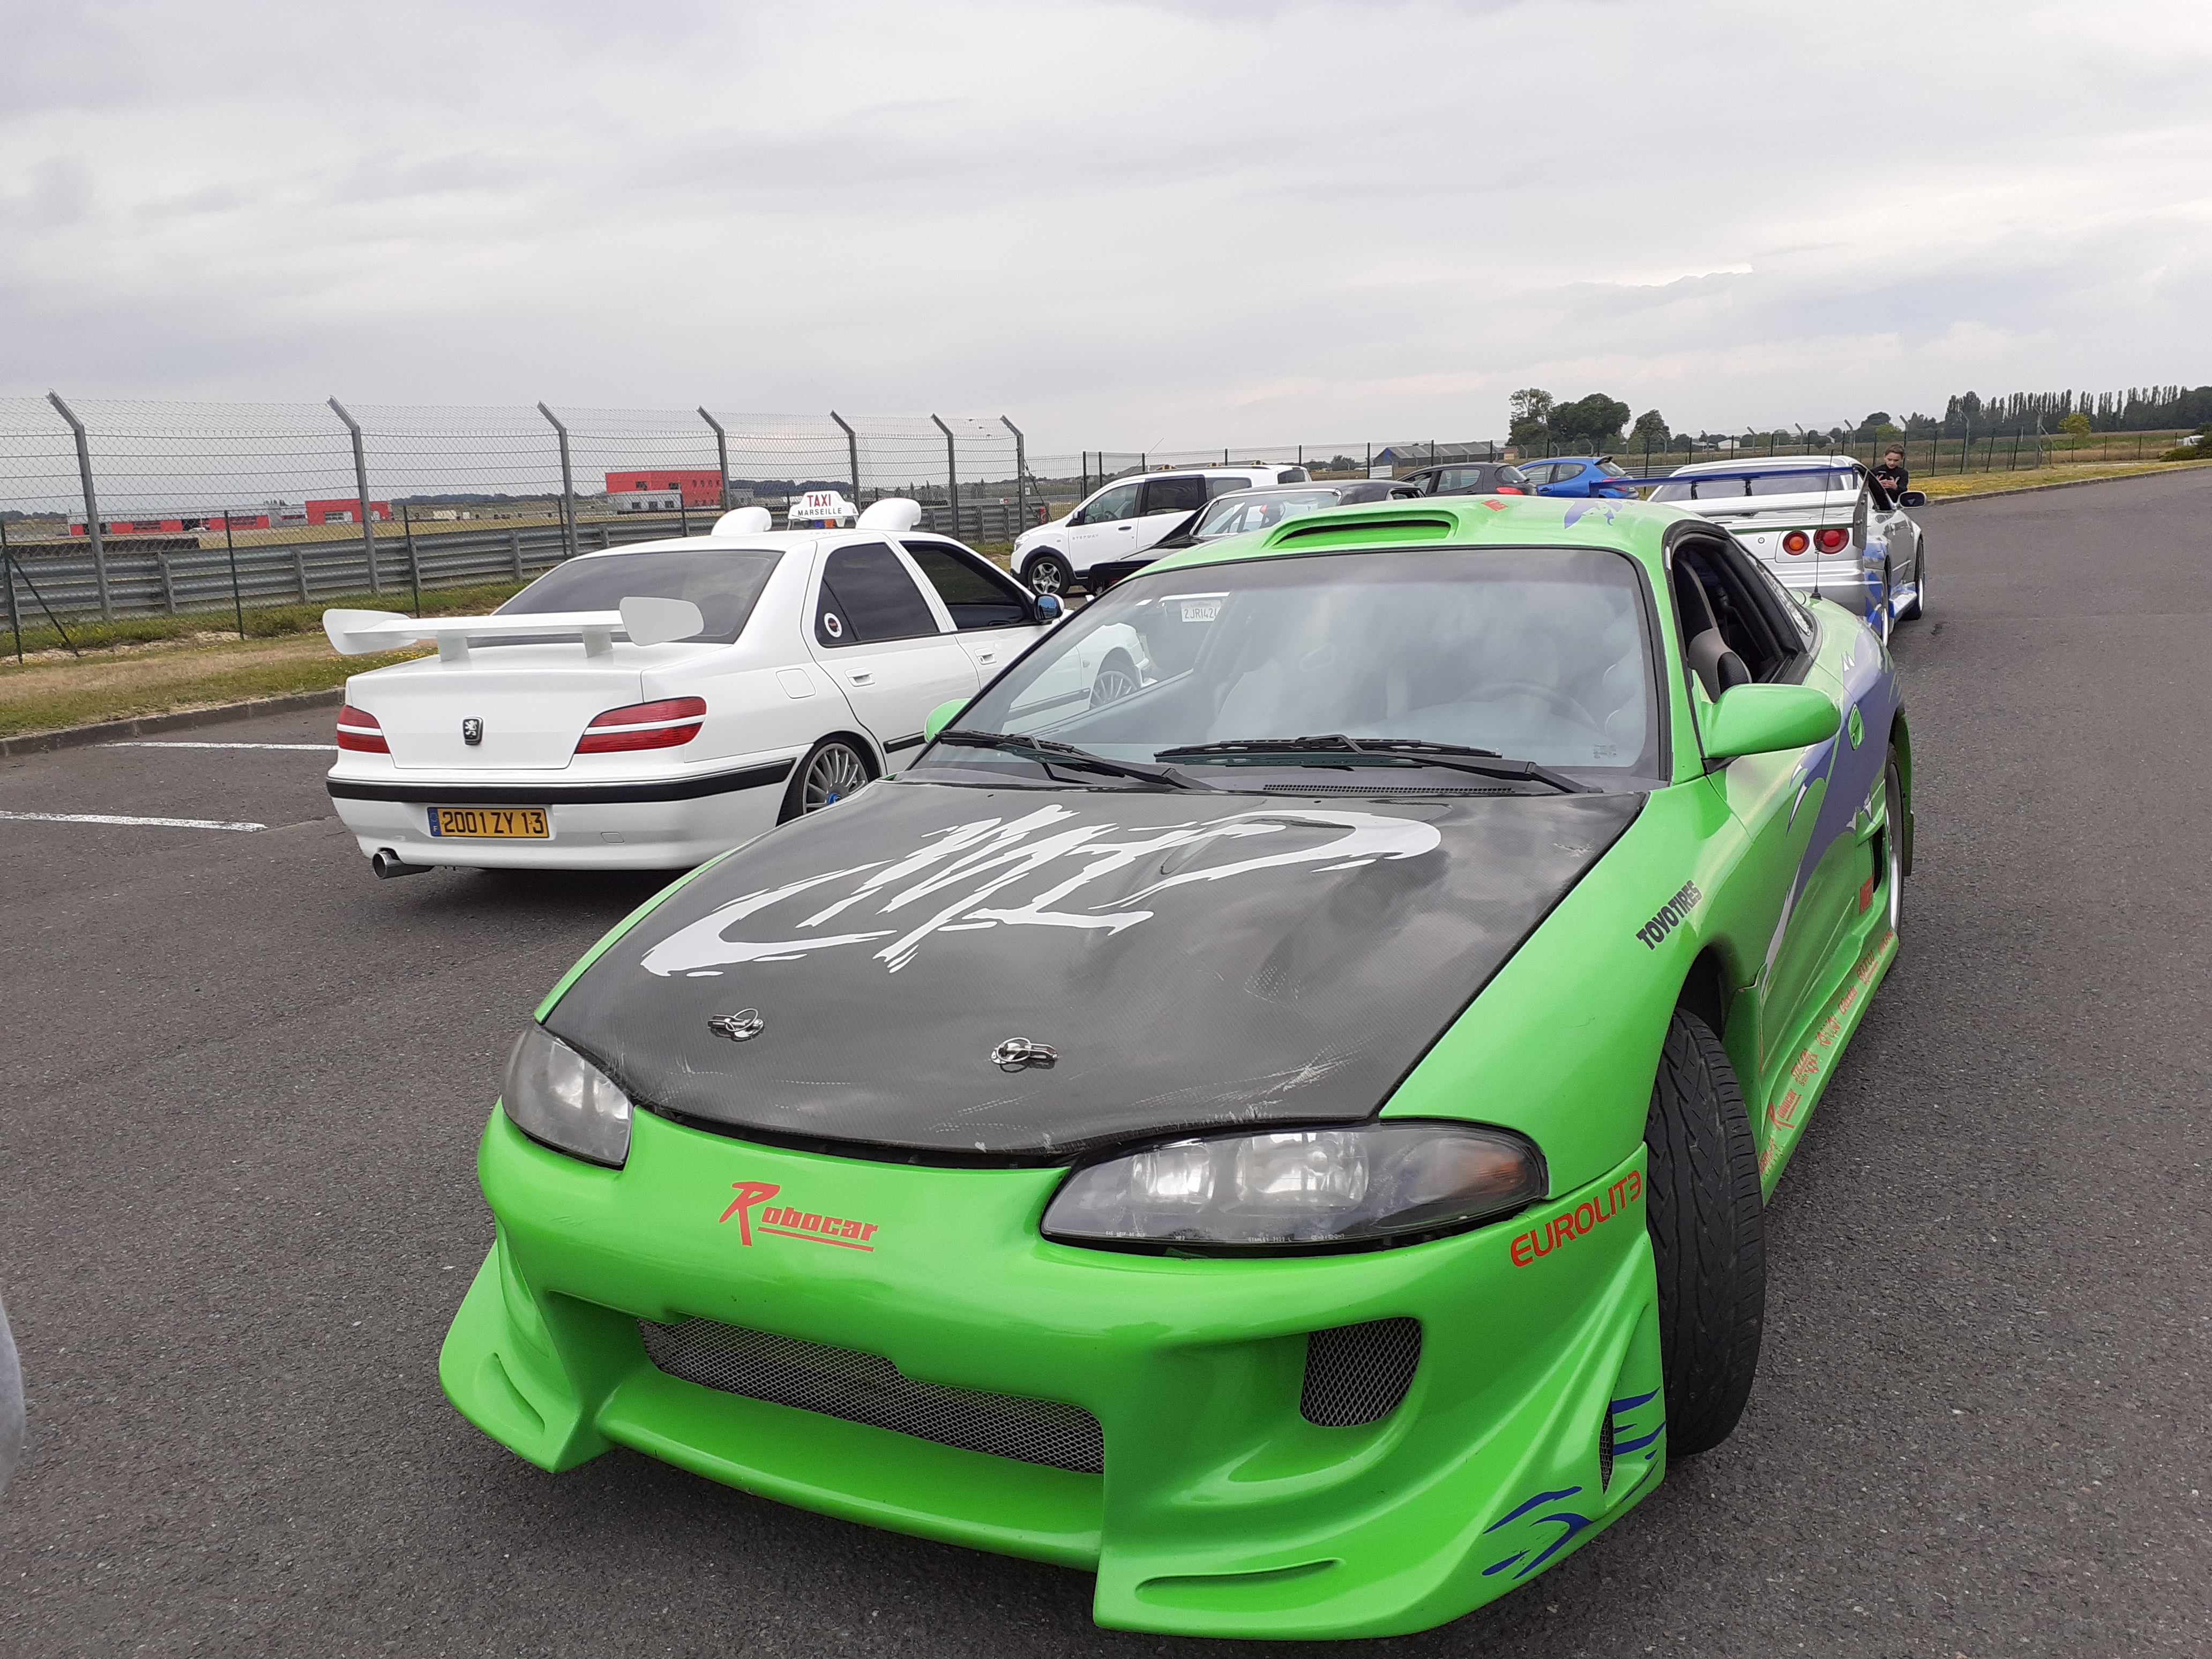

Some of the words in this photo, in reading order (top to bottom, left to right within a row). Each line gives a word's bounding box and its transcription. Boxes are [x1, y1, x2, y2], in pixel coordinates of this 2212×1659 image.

[806, 494, 831, 507] TAXI
[797, 507, 842, 516] MARSEILLE
[443, 811, 487, 834] 2001
[490, 812, 514, 834] ZY
[521, 812, 544, 834] 13
[719, 1181, 878, 1246] Robocar
